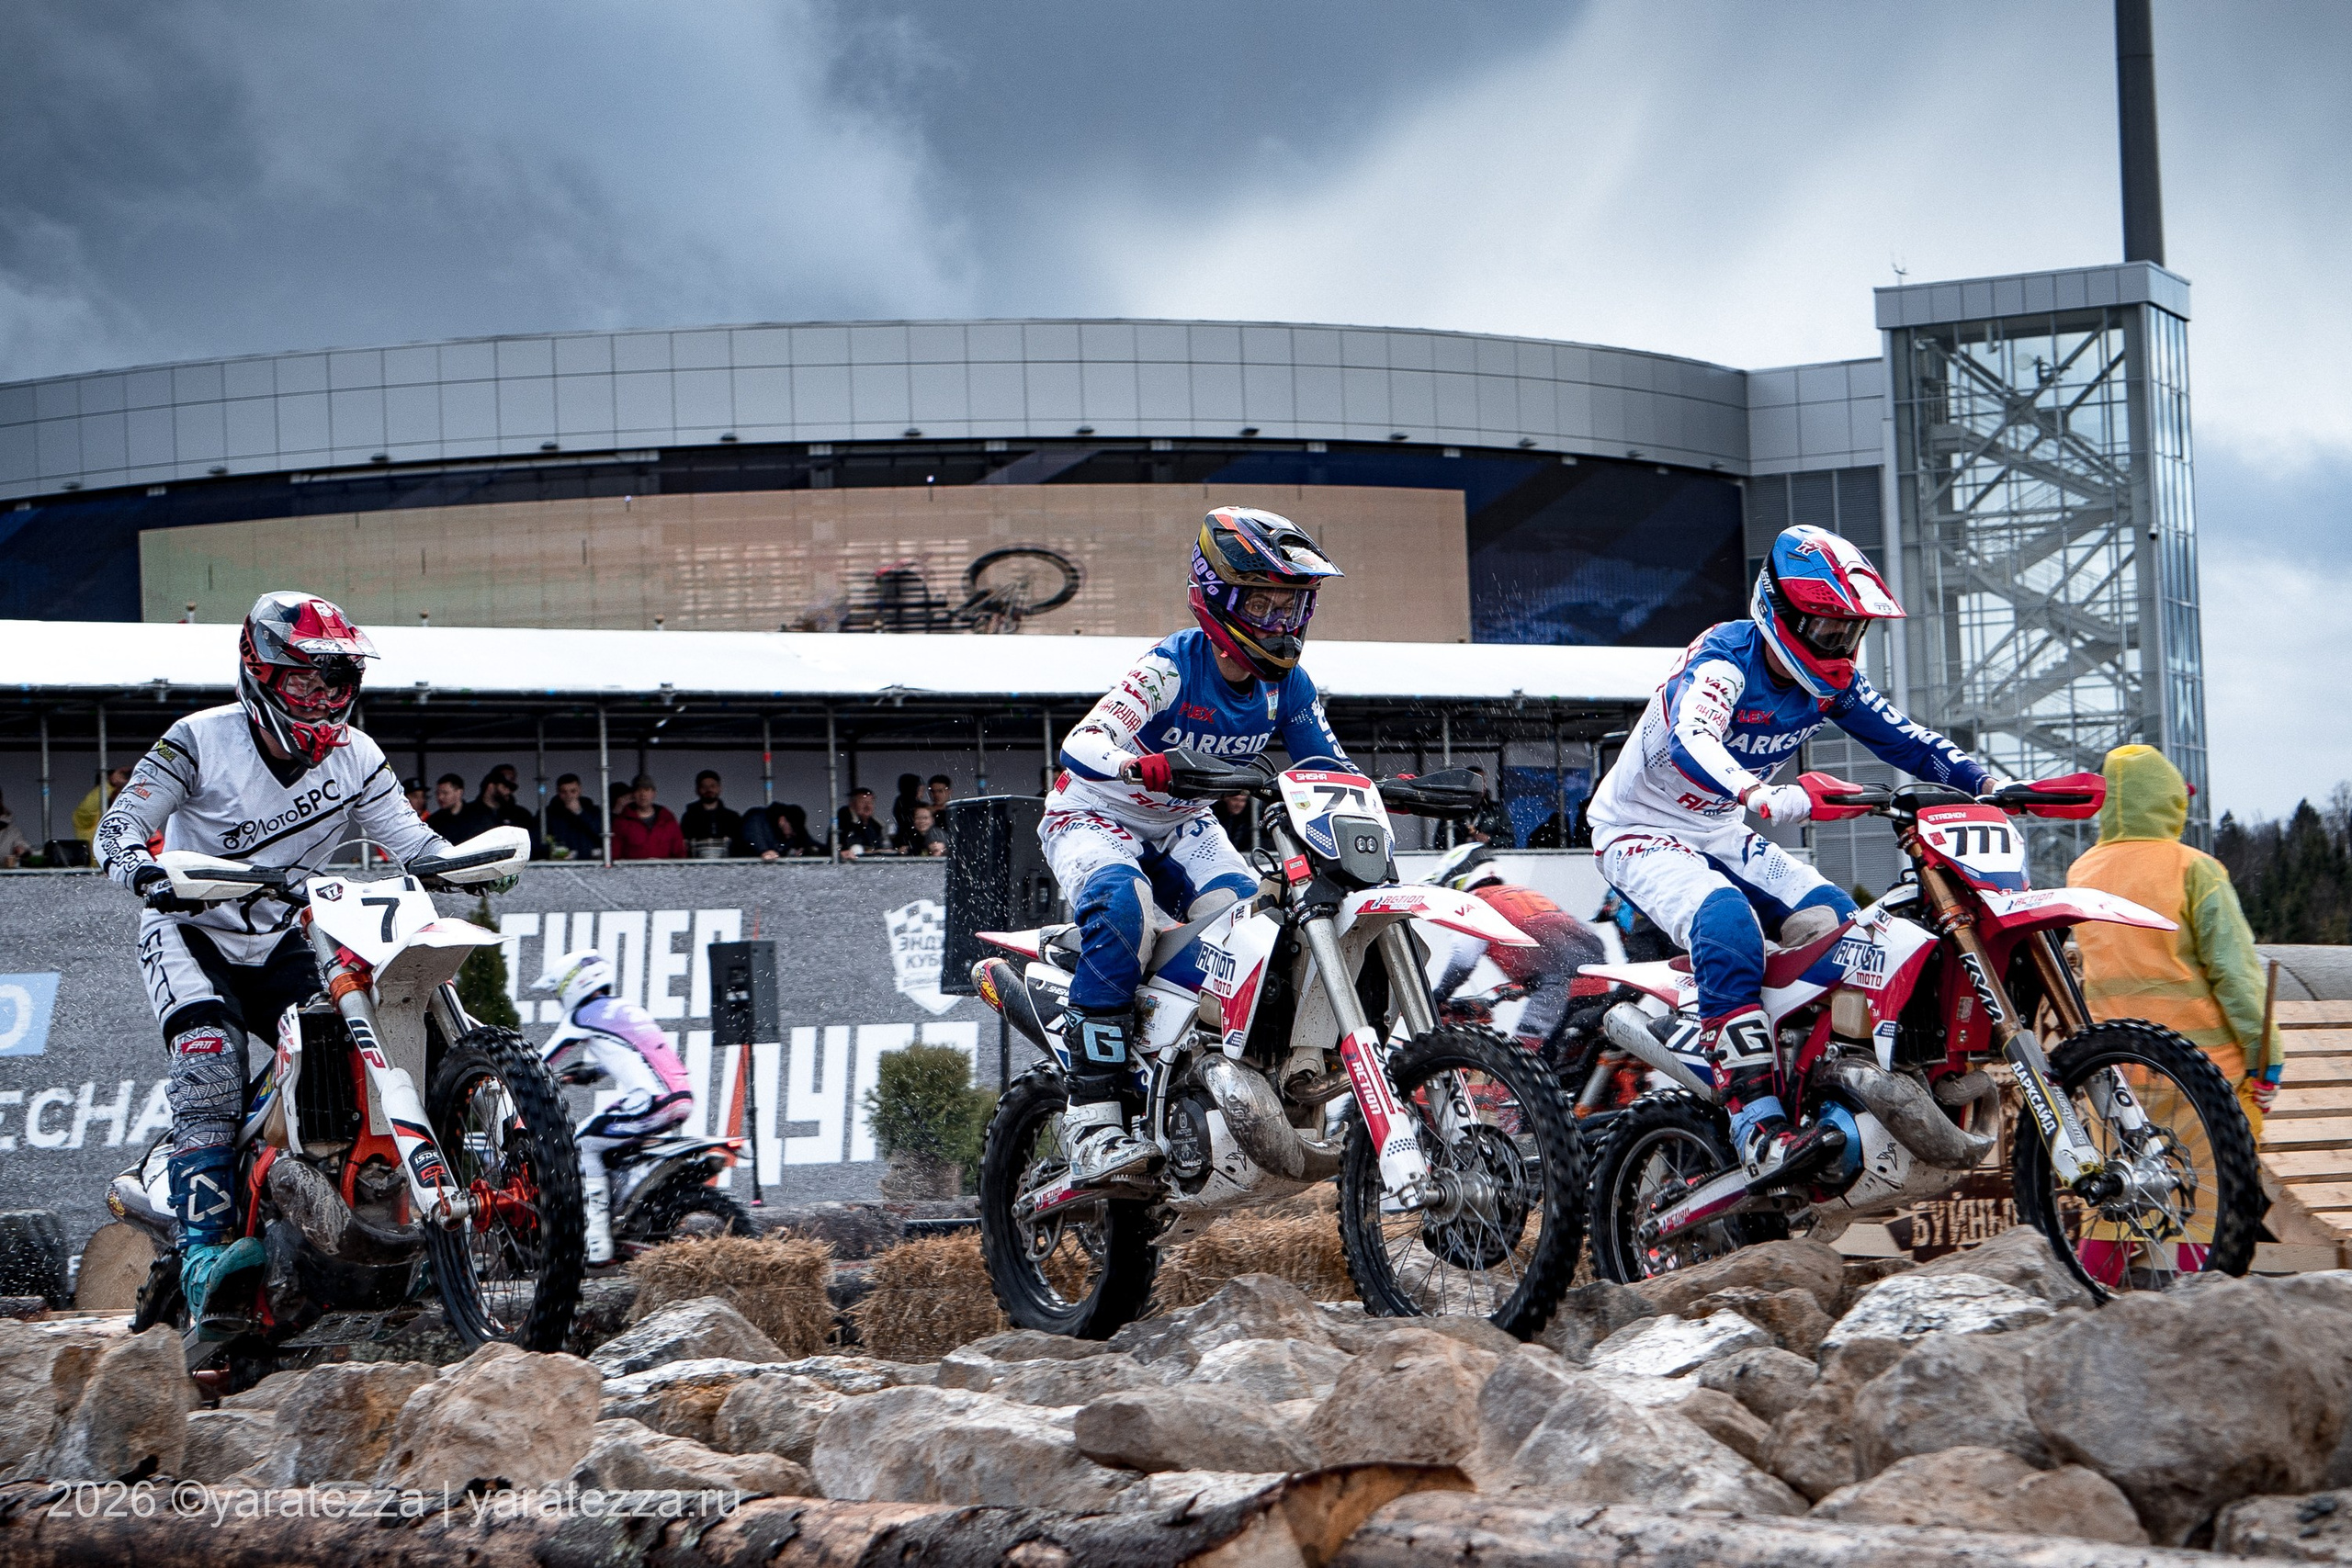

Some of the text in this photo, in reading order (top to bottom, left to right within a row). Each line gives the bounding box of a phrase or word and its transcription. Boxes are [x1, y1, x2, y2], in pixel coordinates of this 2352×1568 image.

[1178, 701, 1217, 724] FLEX
[1160, 725, 1276, 755] DARKSID
[1313, 785, 1370, 812] 71
[1944, 825, 2010, 857] 777
[361, 897, 401, 943] 7
[1196, 946, 1237, 982] ACTION
[1834, 942, 1886, 974] ACTION
[1212, 977, 1232, 996] MOTO
[1856, 972, 1883, 987] MOTO
[1082, 1021, 1127, 1064] G
[1726, 1019, 1773, 1056] G
[1351, 1061, 1383, 1116] ACTION
[2010, 1060, 2058, 1135] ДАРКСАЙД
